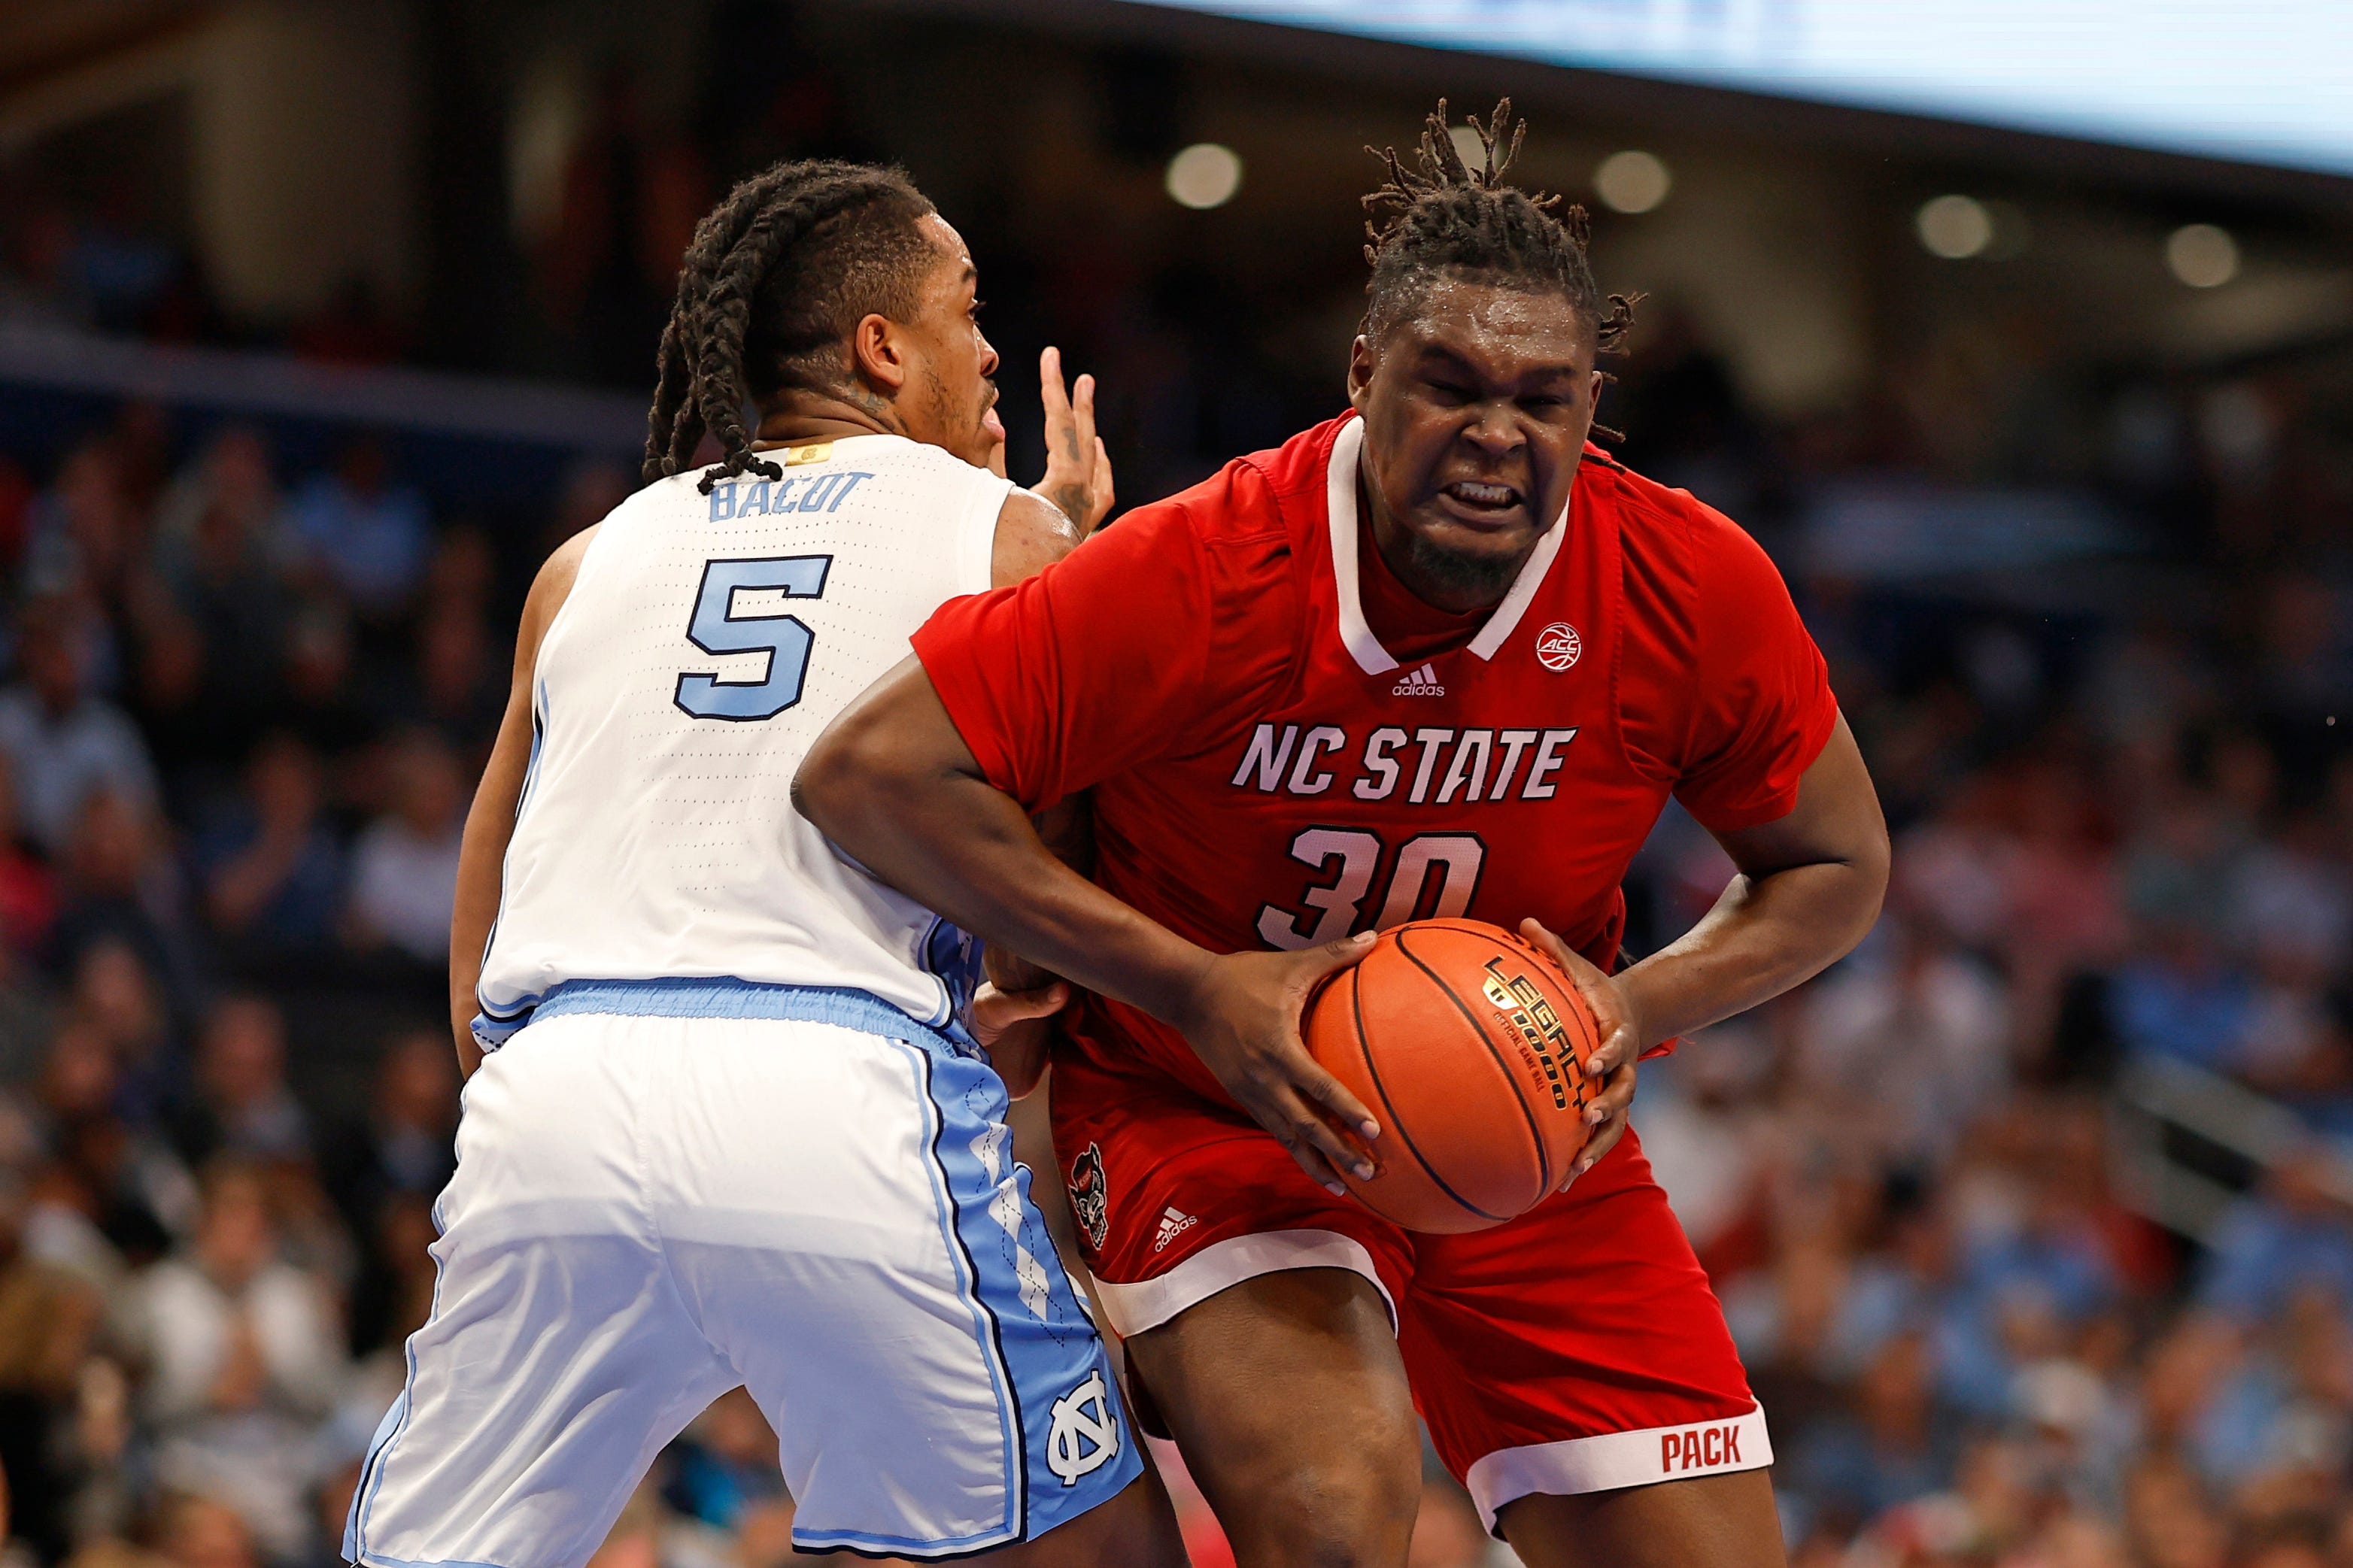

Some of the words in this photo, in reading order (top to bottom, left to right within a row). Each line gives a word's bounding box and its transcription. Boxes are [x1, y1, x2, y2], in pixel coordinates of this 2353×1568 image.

[709, 472, 876, 523] BACOT
[673, 555, 833, 722] 5
[1540, 638, 1580, 651] ACC
[1392, 682, 1445, 697] adidas
[1231, 723, 1346, 795] NC
[1353, 725, 1578, 804] STATE
[1255, 825, 1486, 951] 30
[1483, 954, 1589, 1115] LEGACY
[1493, 1011, 1523, 1048] OFFICIAL
[1520, 1047, 1536, 1071] GAME
[1532, 1070, 1545, 1093] BALL
[1510, 1009, 1567, 1111] 1000
[1155, 1215, 1198, 1252] adidas
[1662, 1425, 1741, 1473] PACK
